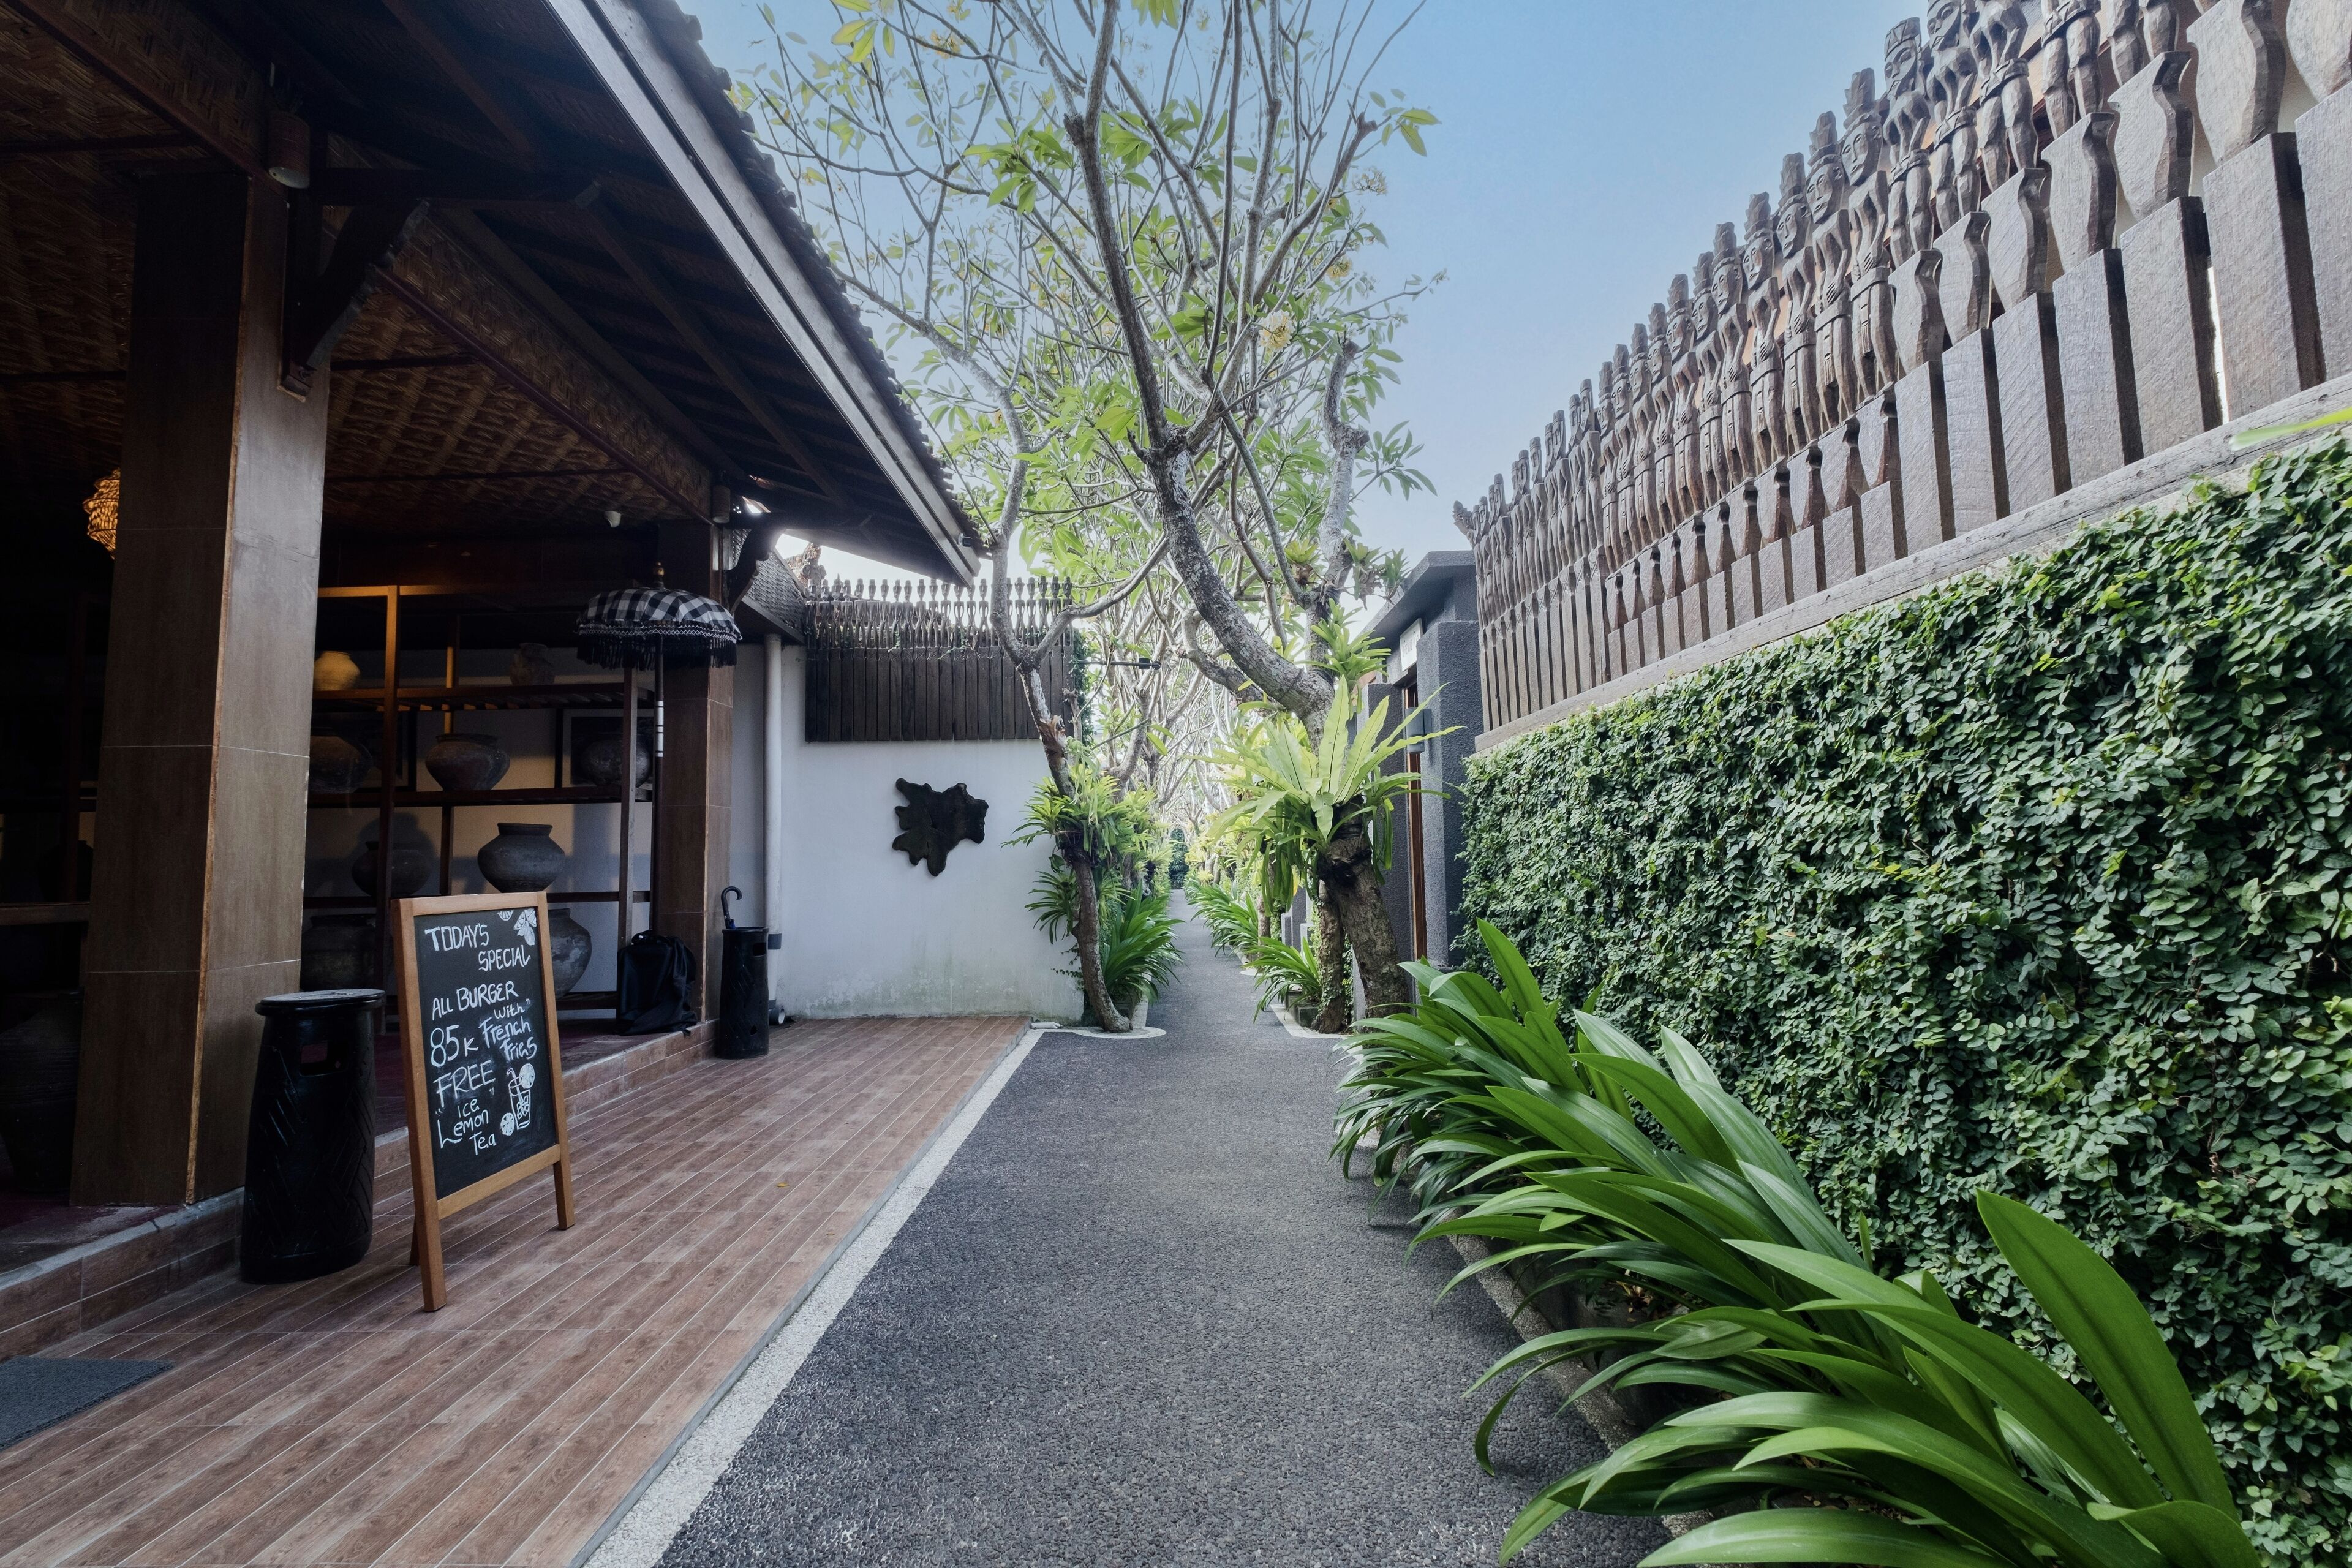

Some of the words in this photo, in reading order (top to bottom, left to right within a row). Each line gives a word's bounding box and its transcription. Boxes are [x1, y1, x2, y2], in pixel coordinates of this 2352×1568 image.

[424, 923, 489, 951] TODAY'S
[478, 944, 531, 971] SPECIAL
[432, 998, 453, 1021] ALL
[456, 981, 519, 1011] BURGER
[478, 1016, 531, 1049] French
[500, 1036, 537, 1061] Fries
[433, 1060, 496, 1108] FREE
[469, 1131, 497, 1156] Tea
